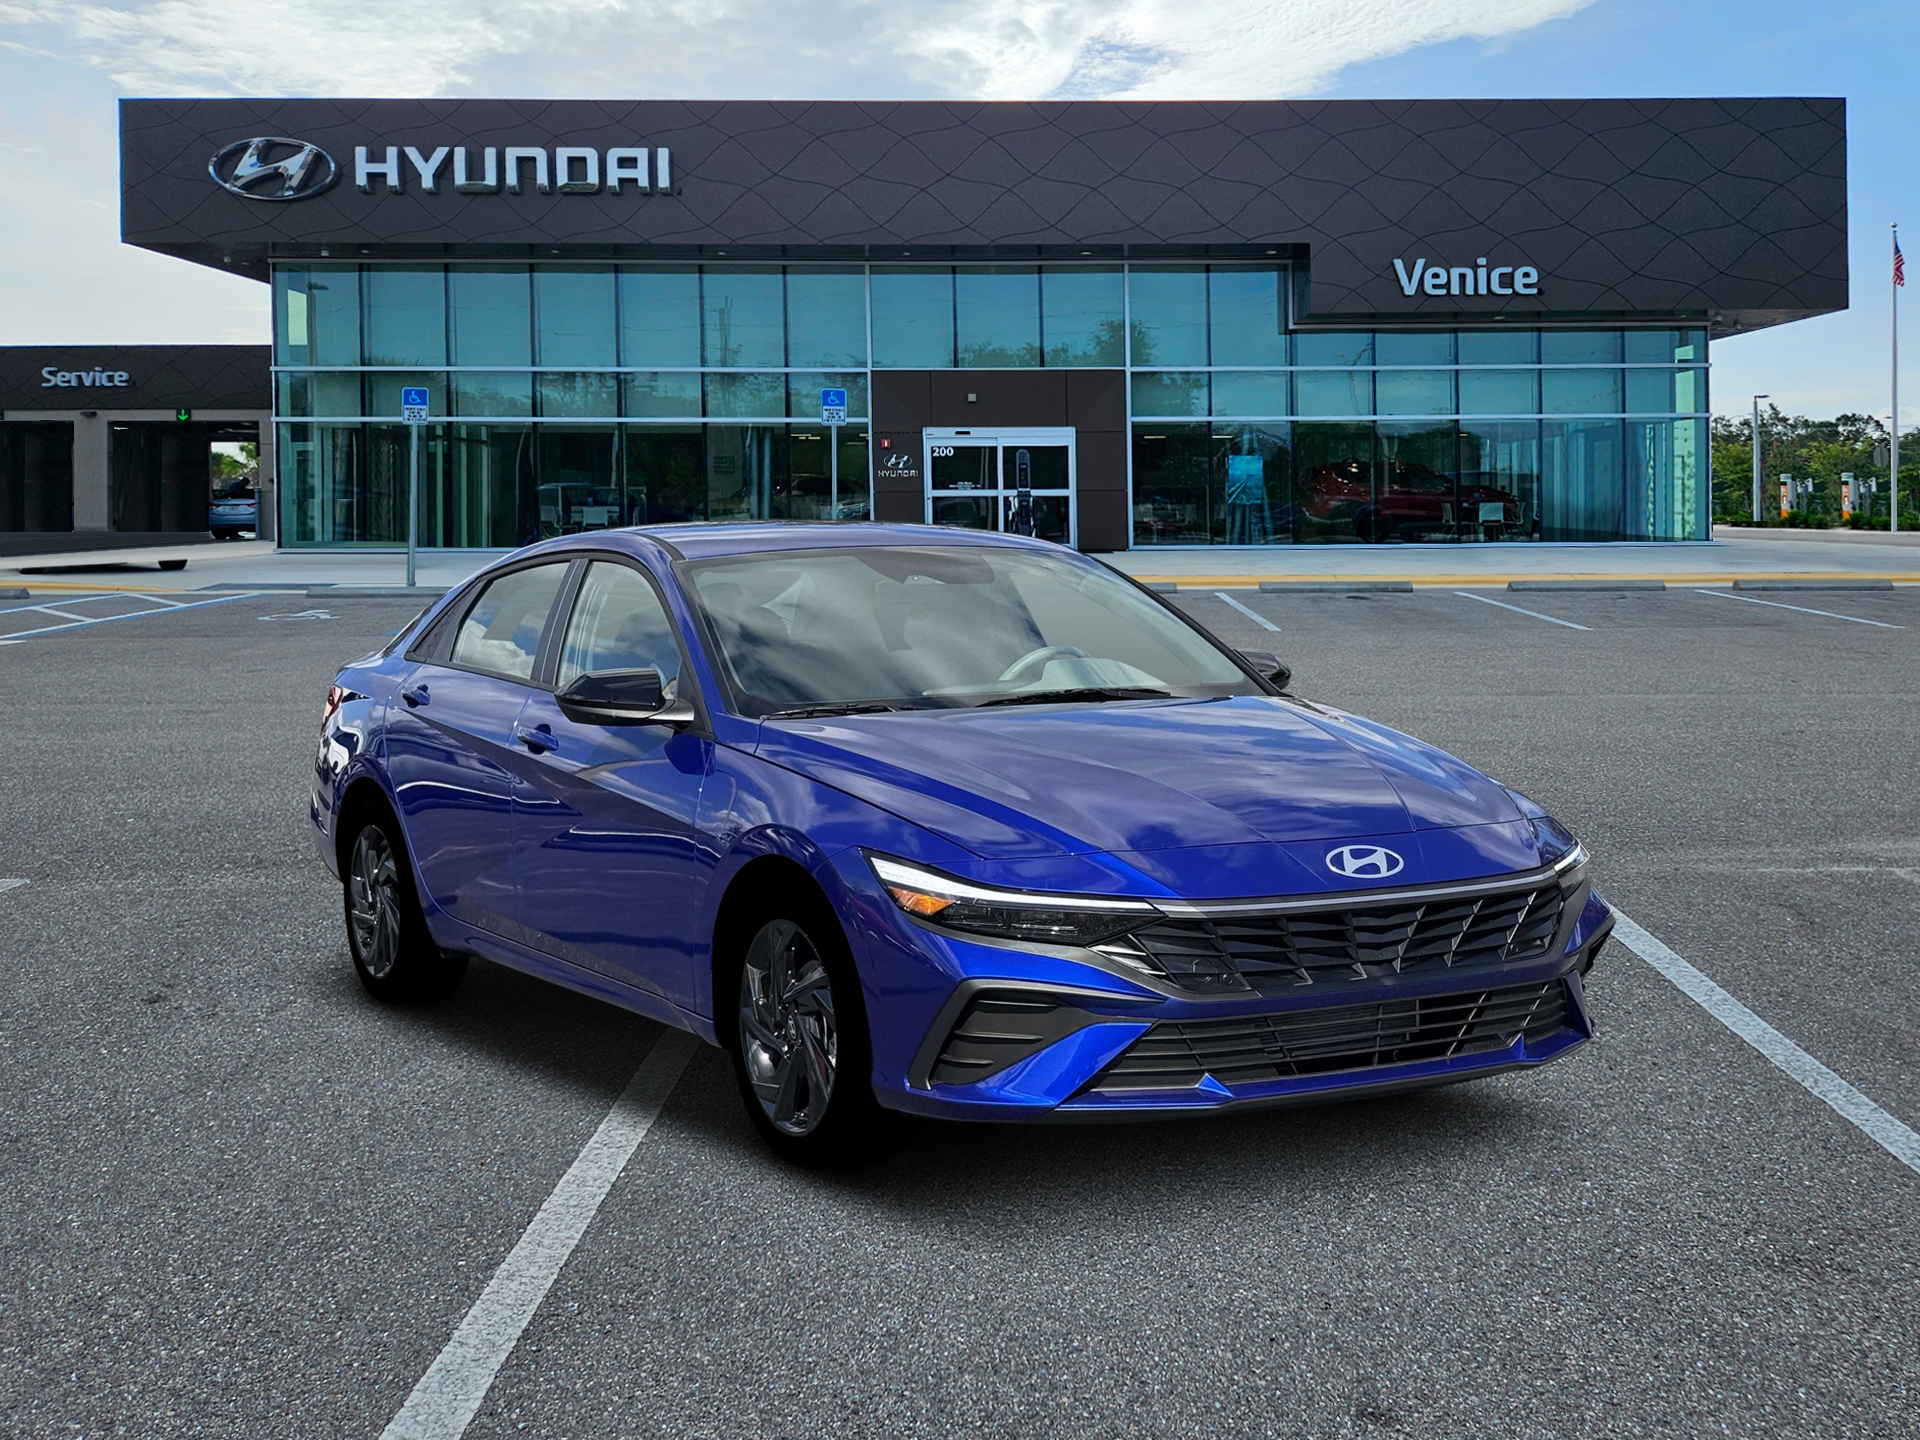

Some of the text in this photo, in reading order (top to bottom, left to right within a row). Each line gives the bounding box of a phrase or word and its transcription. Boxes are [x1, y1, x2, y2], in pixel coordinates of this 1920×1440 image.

[354, 146, 670, 194] HYUNDAI
[1392, 257, 1539, 296] Venice
[41, 366, 130, 387] Service
[932, 447, 954, 457] 200
[877, 470, 919, 478] HYUNDAI
